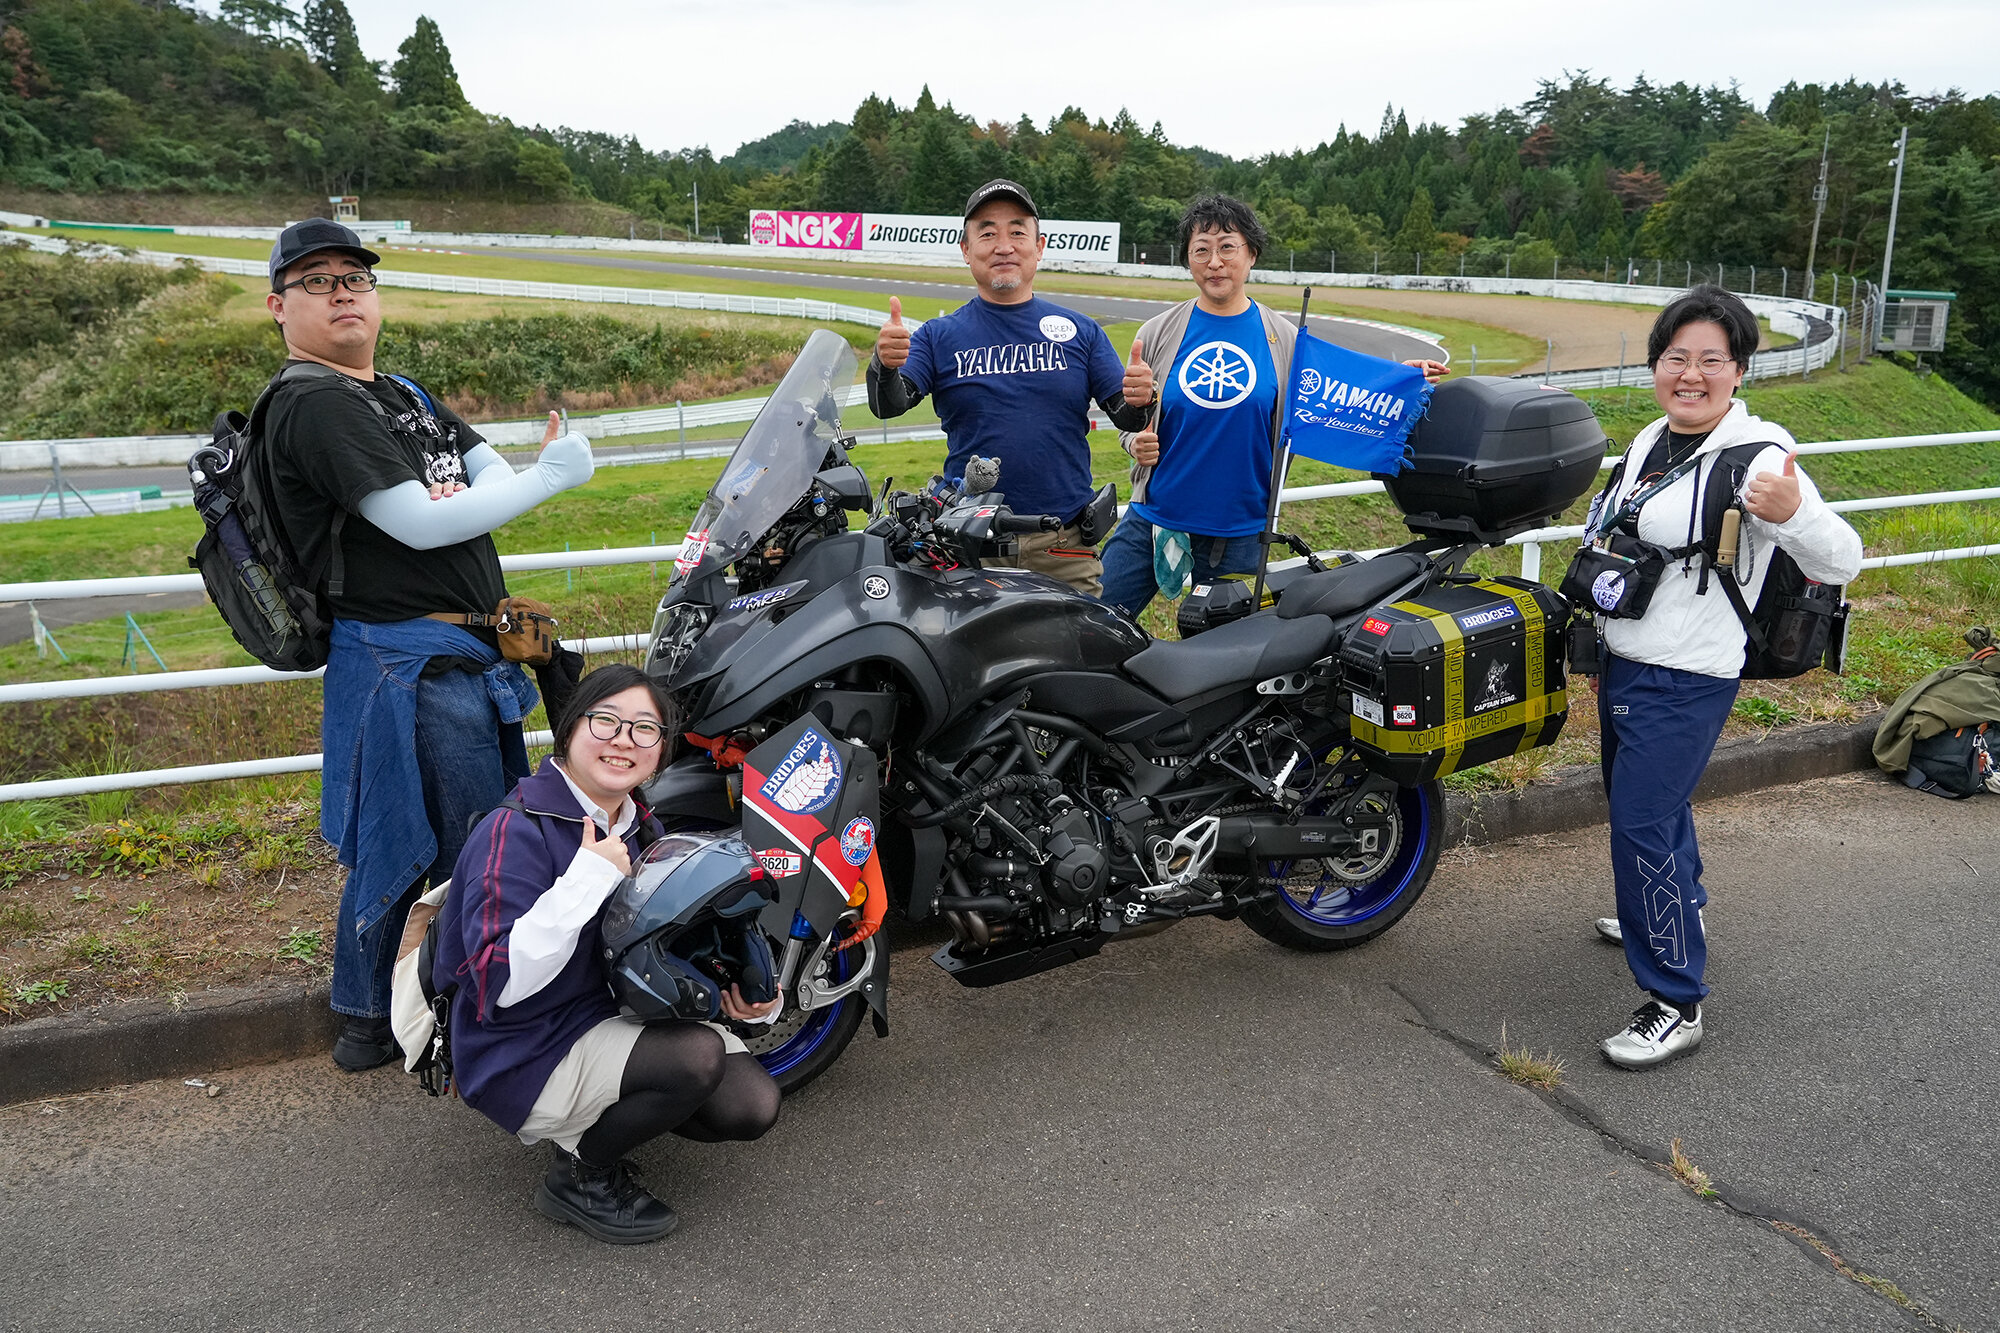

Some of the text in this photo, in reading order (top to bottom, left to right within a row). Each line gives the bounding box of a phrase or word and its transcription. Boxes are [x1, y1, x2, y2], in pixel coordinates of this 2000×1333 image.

[778, 214, 843, 247] NGK
[954, 342, 1067, 378] YAMAHA
[1298, 395, 1389, 427] RACING
[1321, 377, 1405, 421] YAMAHA
[1352, 423, 1385, 436] Heart
[1462, 606, 1515, 628] BRIDGES
[1396, 712, 1413, 720] 8620
[1474, 699, 1500, 712] CAPTAIN
[1500, 694, 1516, 704] STAG
[1407, 730, 1435, 747] VOID
[1439, 726, 1448, 742] IF
[1453, 709, 1508, 737] TAMPERED
[761, 730, 818, 797] BRIDGES
